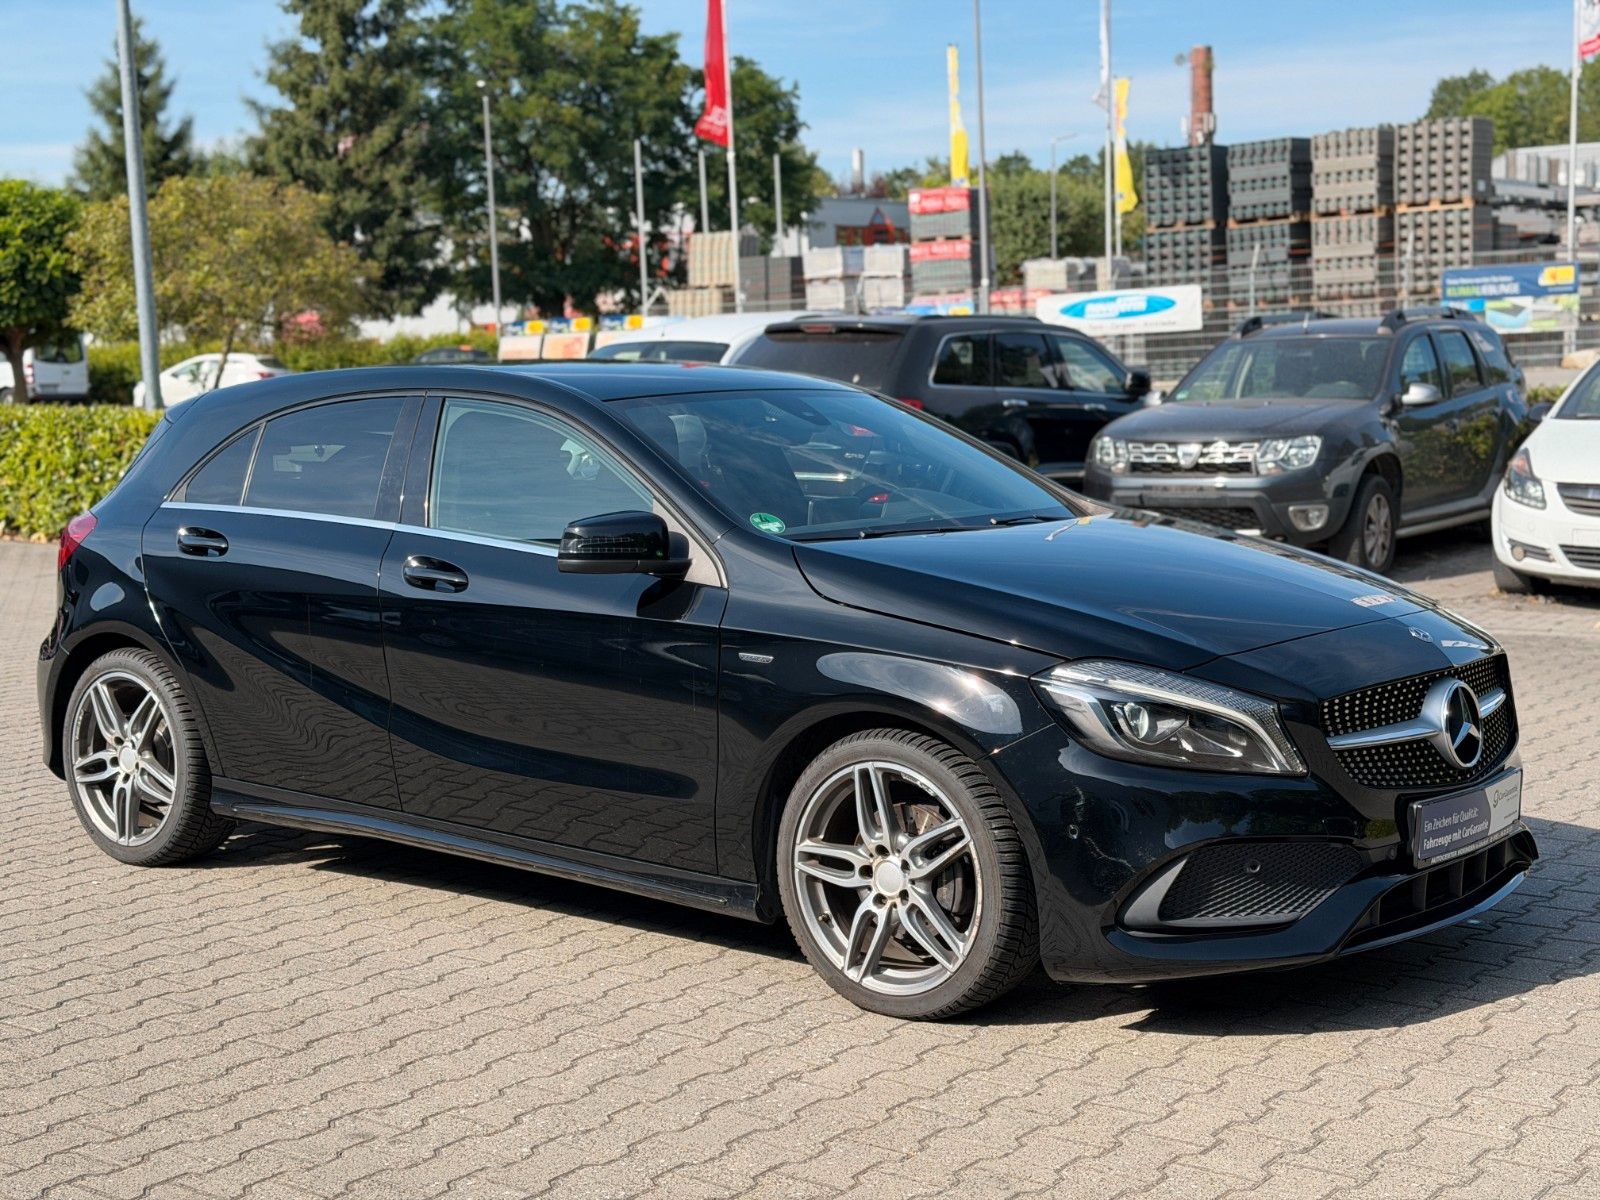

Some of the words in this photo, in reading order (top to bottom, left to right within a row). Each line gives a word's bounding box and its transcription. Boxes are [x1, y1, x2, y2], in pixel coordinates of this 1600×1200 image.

[1433, 816, 1452, 830] Zeichen
[1423, 834, 1452, 850] Fahrzeuge
[1452, 828, 1462, 841] mit
